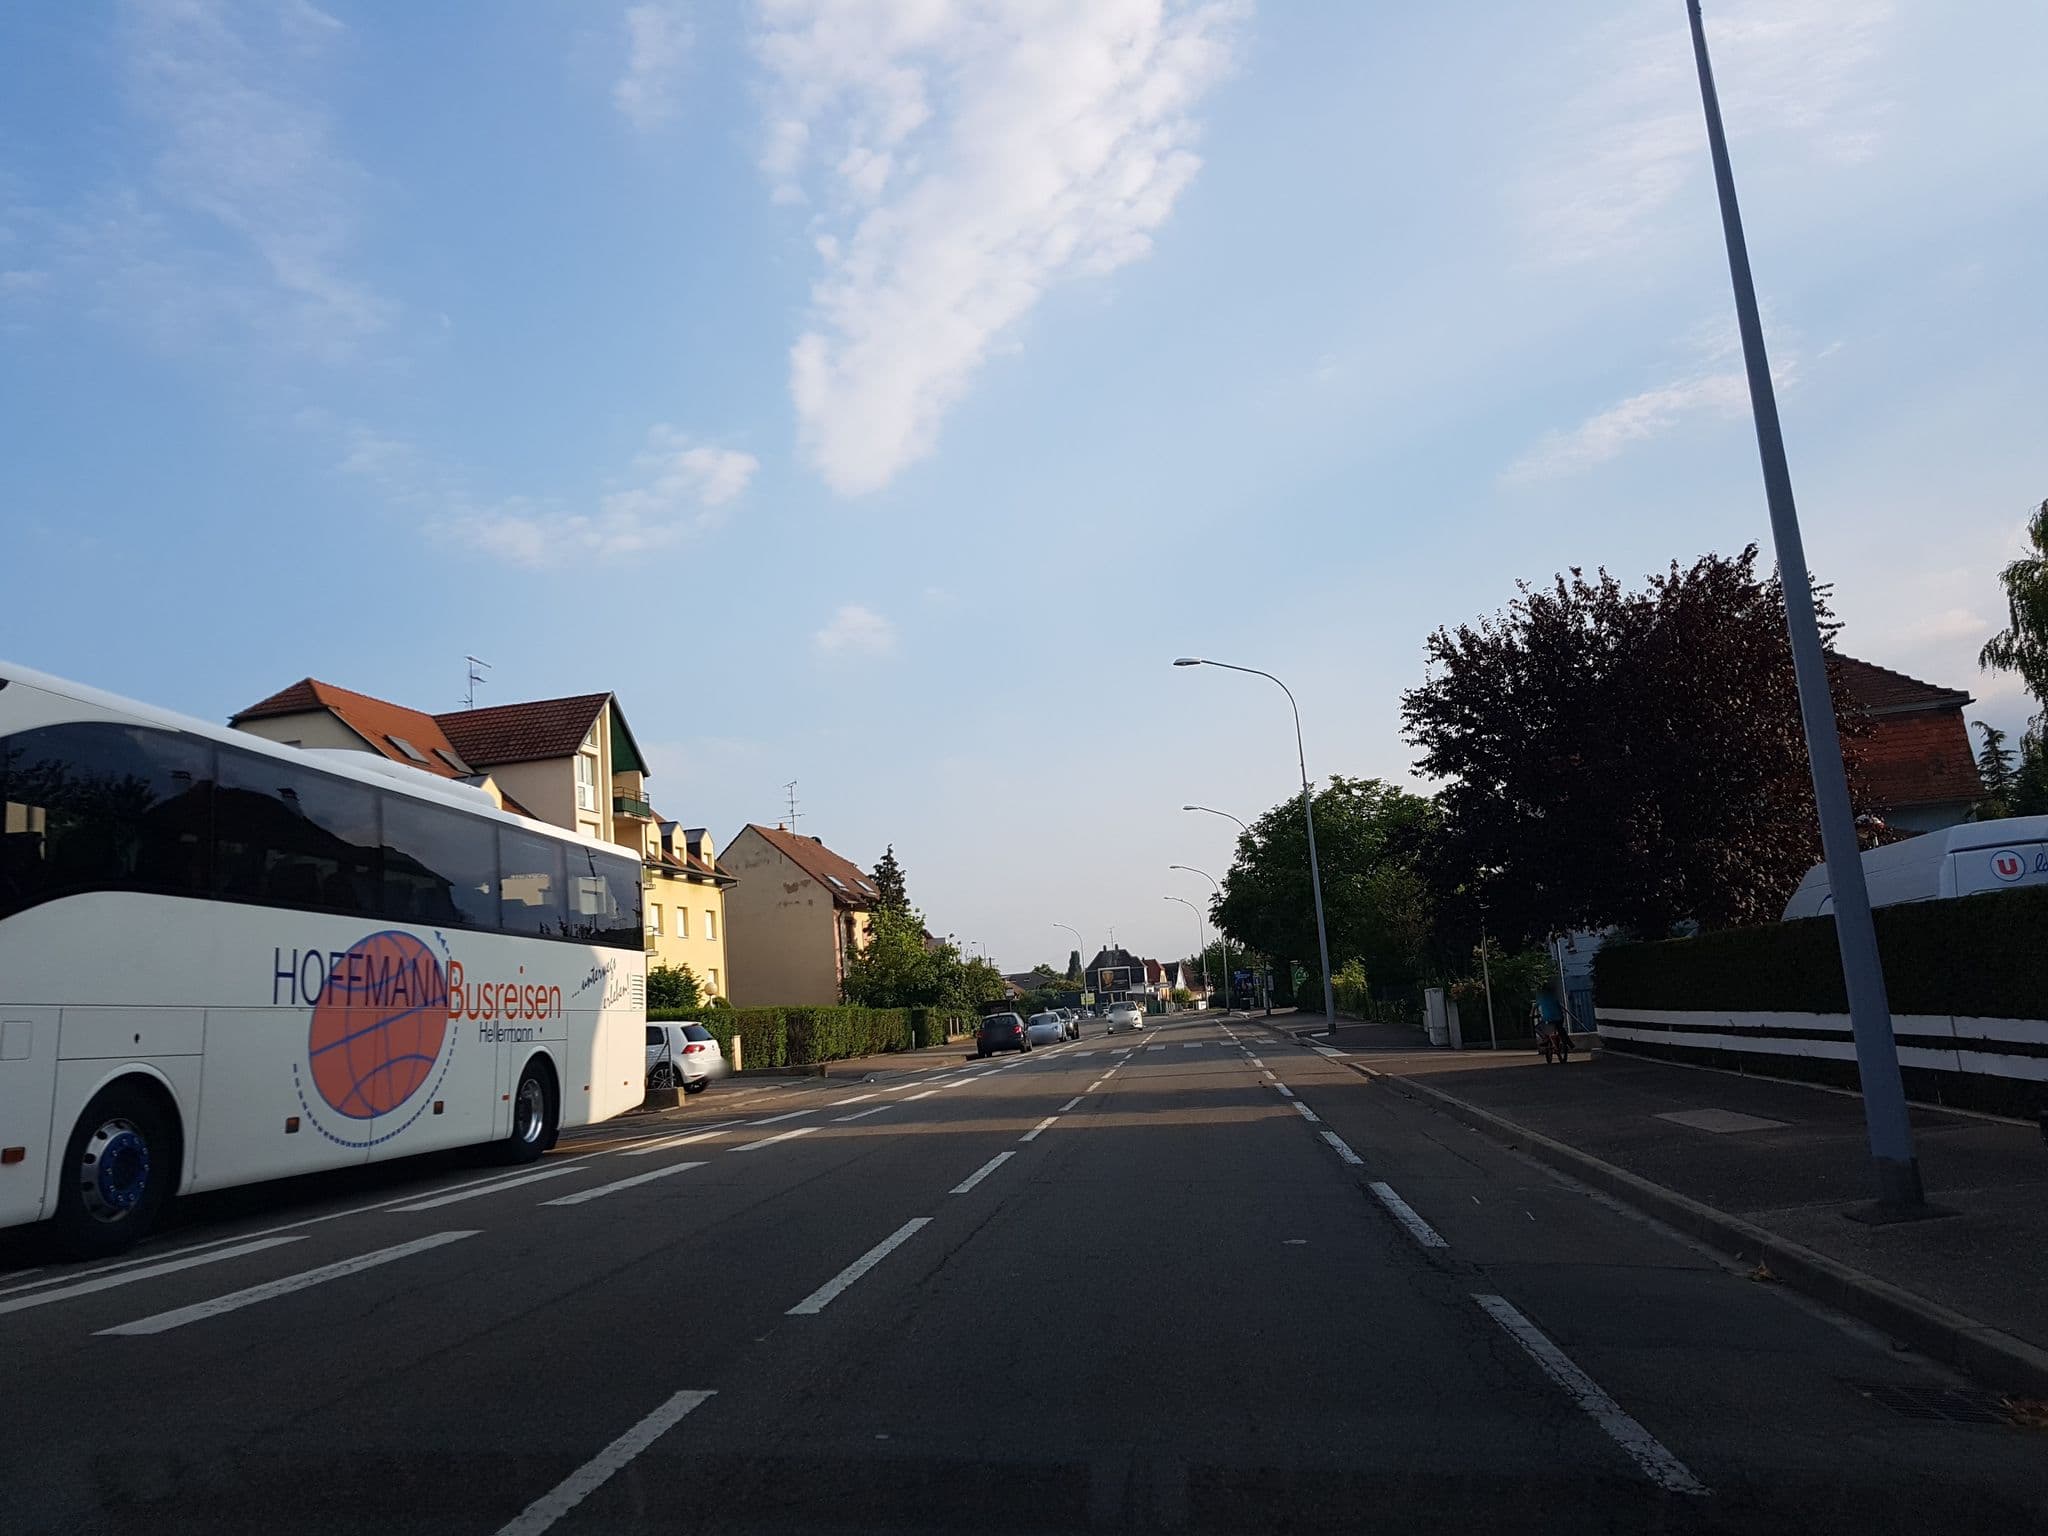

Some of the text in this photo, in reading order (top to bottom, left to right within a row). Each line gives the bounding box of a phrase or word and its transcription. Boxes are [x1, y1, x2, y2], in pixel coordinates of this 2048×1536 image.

[1997, 858, 2018, 875] U
[273, 947, 561, 1020] HOFFMANN Busreisen
[479, 1021, 533, 1043] Hellermann
